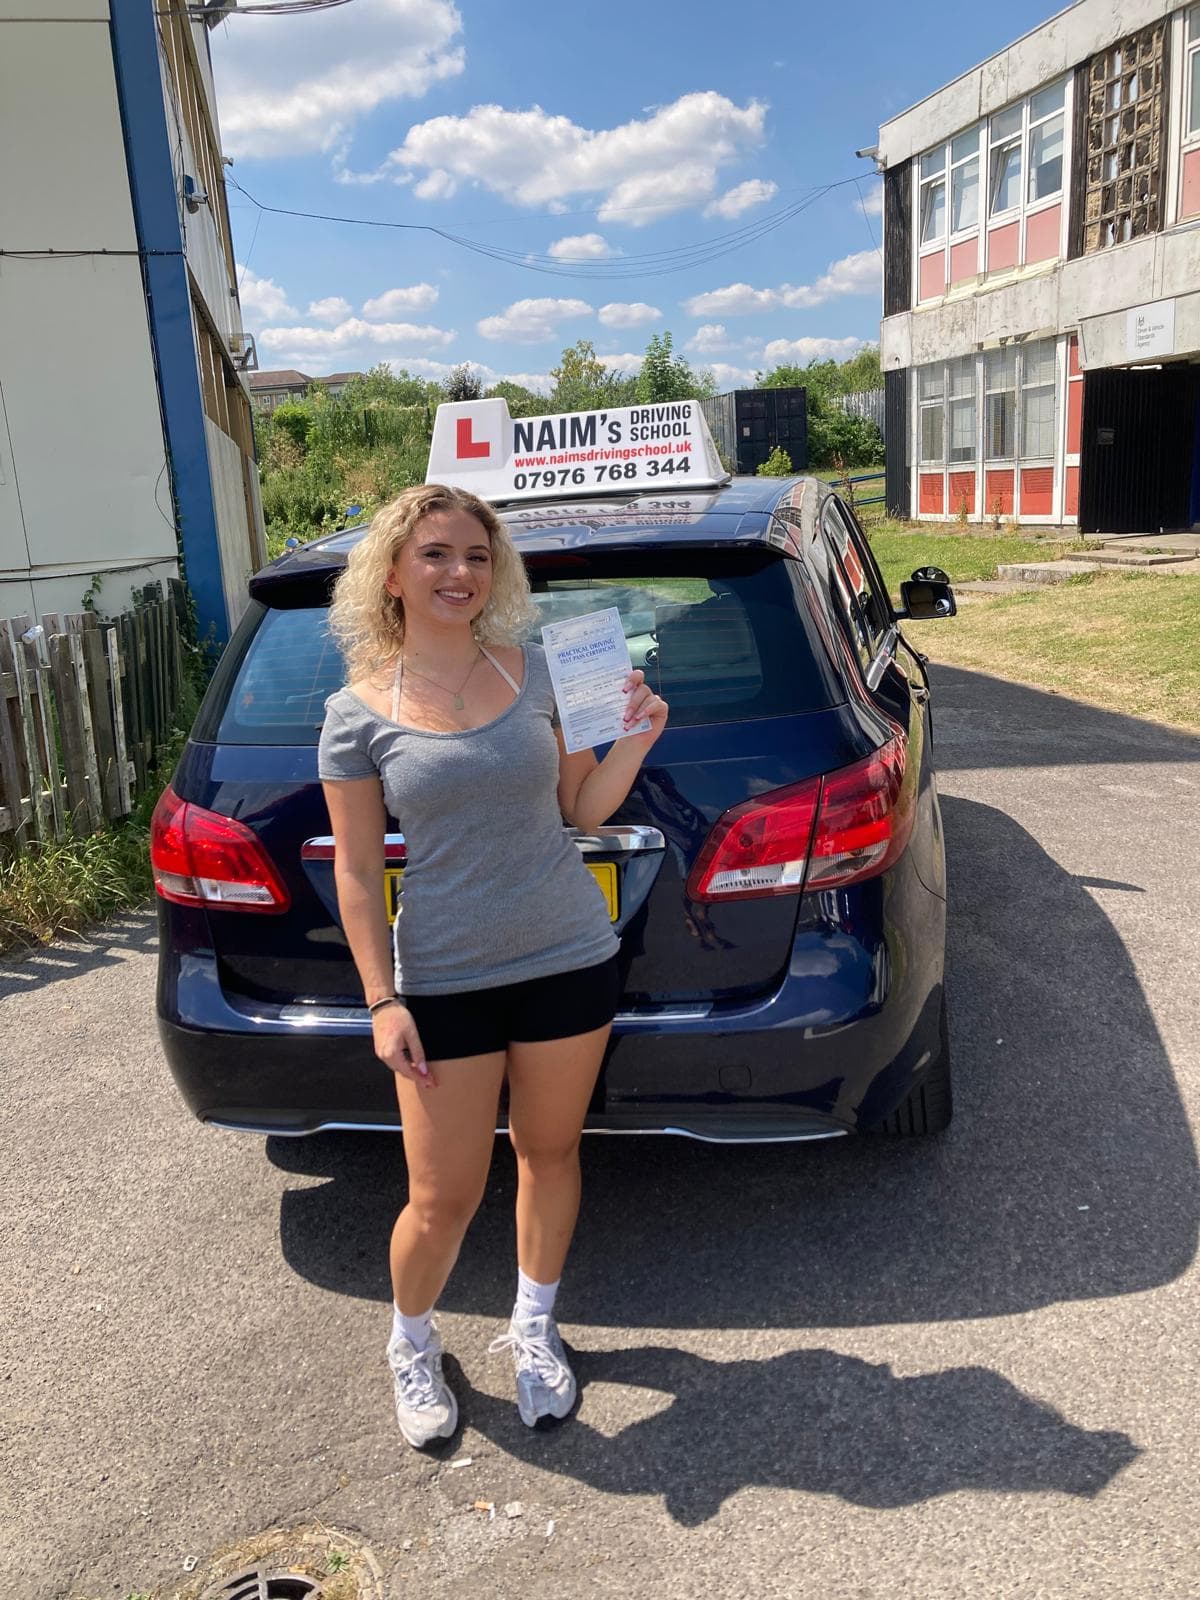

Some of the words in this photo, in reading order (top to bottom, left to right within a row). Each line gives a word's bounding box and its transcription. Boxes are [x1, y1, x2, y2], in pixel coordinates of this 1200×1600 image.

[630, 404, 692, 425] DRIVING
[456, 418, 490, 459] L
[630, 422, 692, 442] SCHOOL
[514, 441, 692, 468] www.naimsdrivingschool.uk
[514, 468, 586, 490] 07976
[594, 462, 637, 483] 768
[646, 456, 691, 477] 344
[558, 645, 589, 659] PRACTICAL
[589, 638, 616, 650] DRIVING
[560, 656, 573, 665] TEST
[573, 653, 586, 662] PASS
[585, 645, 617, 659] CERTIFICATE
